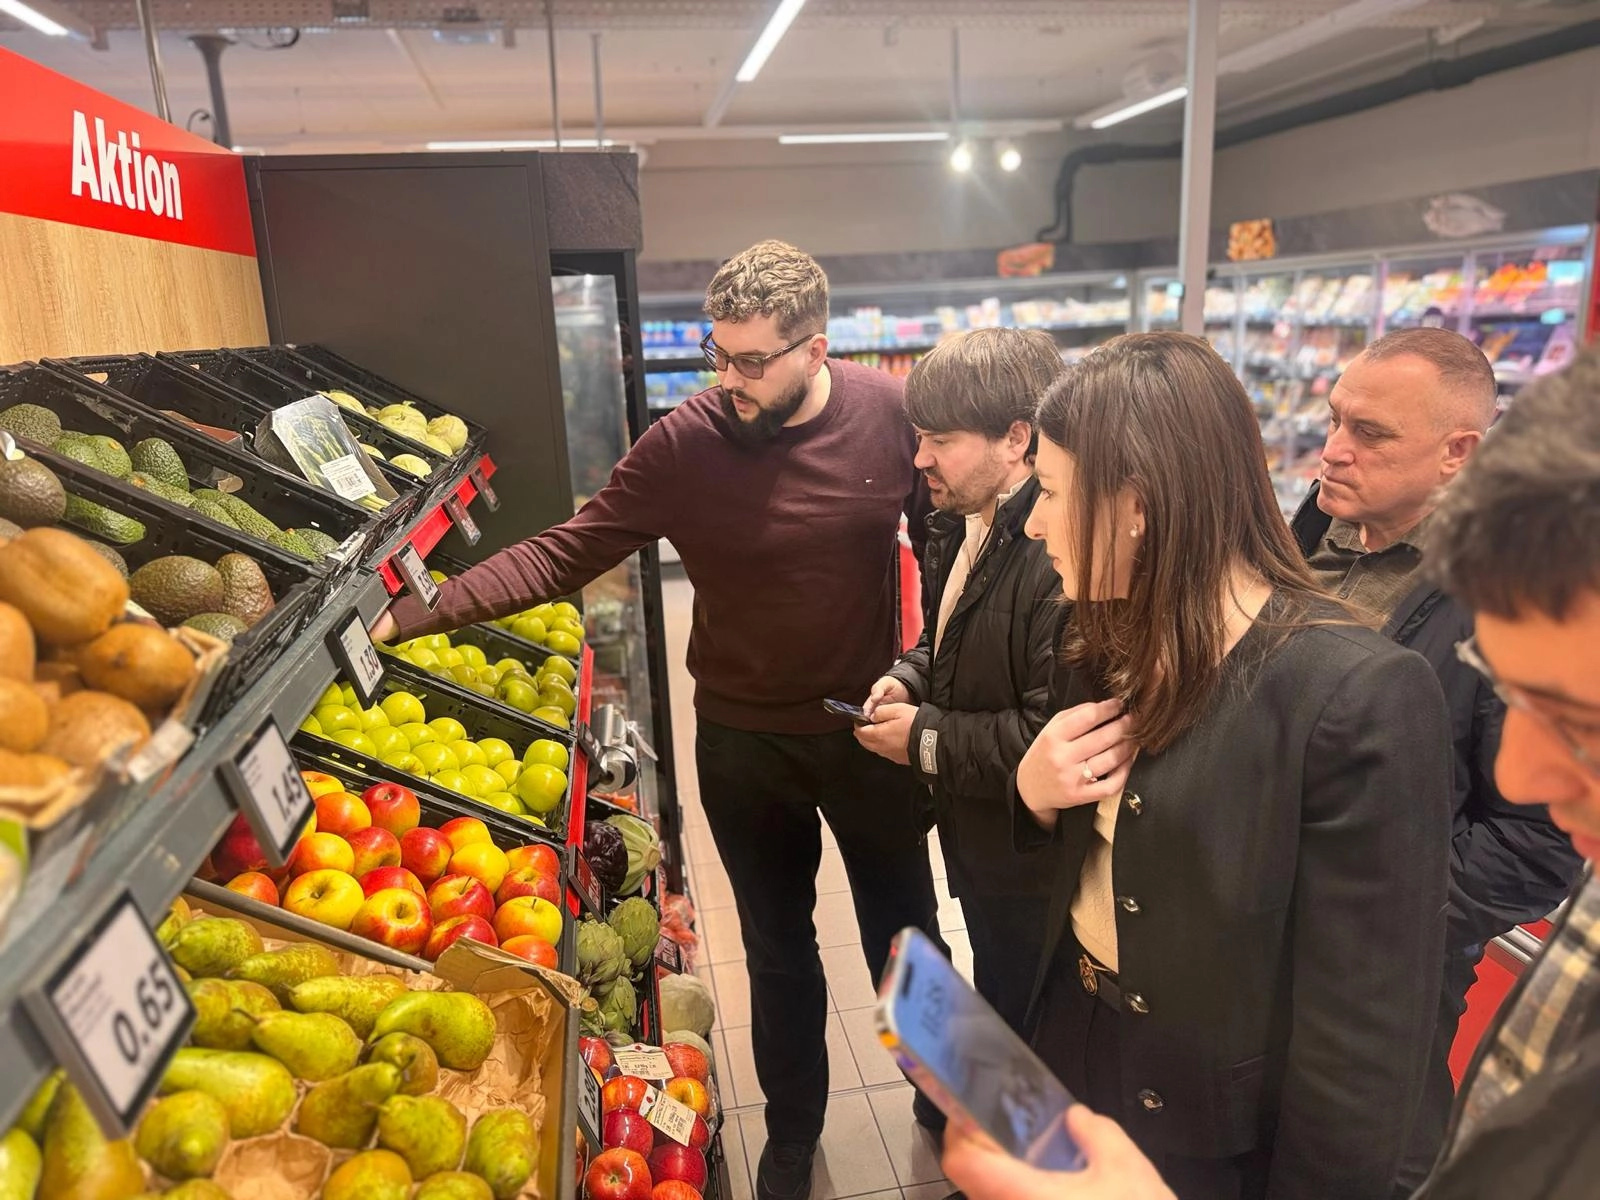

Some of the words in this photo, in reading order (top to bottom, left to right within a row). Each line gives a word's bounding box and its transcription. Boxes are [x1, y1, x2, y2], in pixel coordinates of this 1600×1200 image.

[71, 109, 184, 221] Aktion
[360, 645, 379, 682] 1.30
[272, 766, 302, 821] 1.45
[112, 959, 174, 1066] 0.65
[584, 1067, 596, 1122] 2.80
